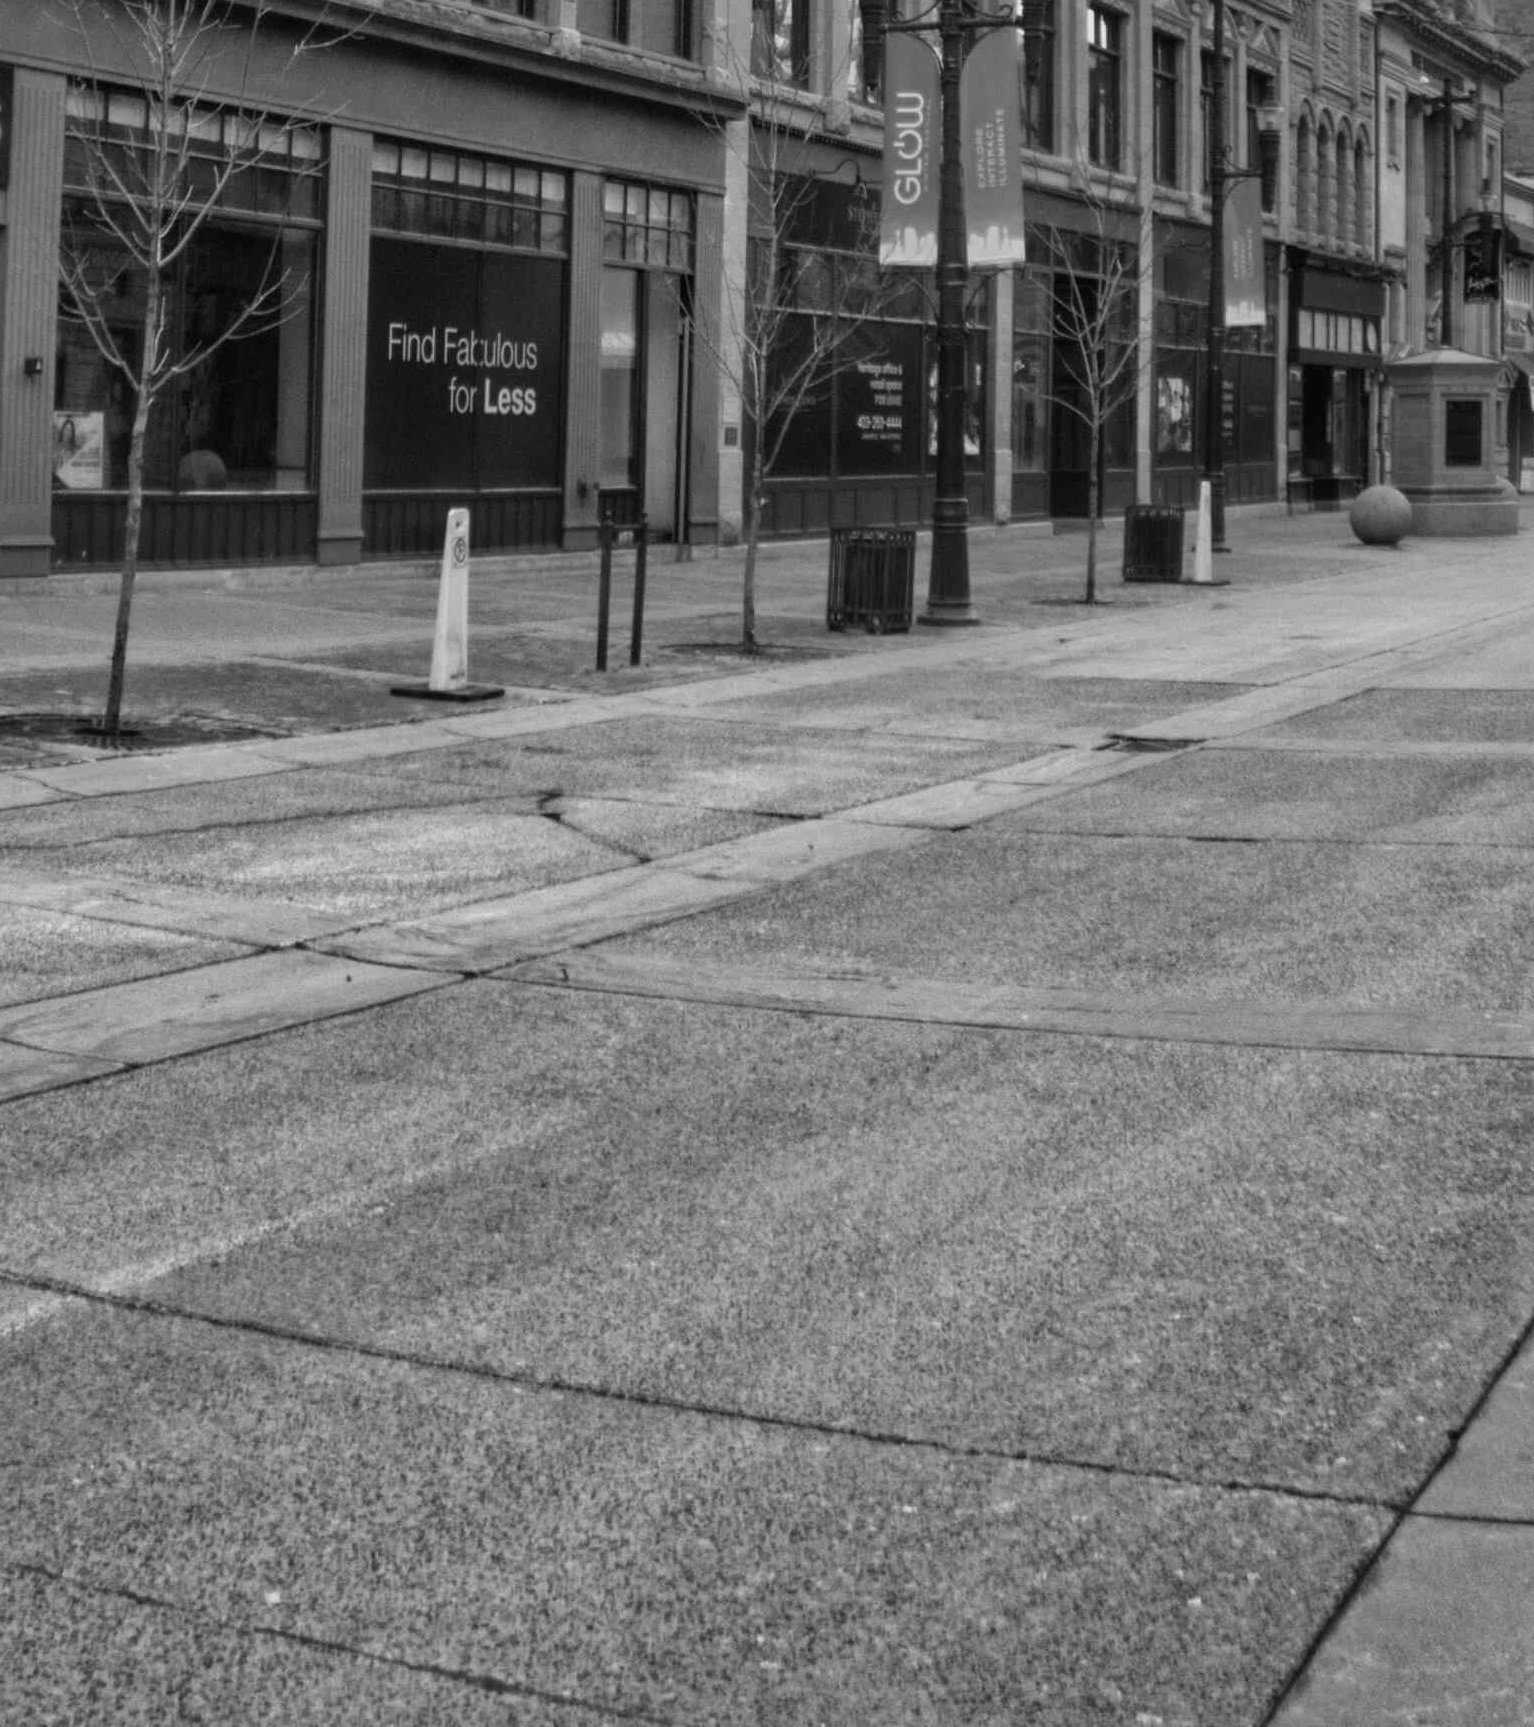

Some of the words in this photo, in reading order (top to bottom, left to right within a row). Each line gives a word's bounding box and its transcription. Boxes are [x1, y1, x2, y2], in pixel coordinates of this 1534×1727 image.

[892, 91, 924, 206] GLOW
[387, 321, 437, 364] Find
[442, 326, 539, 370] Fabulous
[448, 375, 479, 415] for
[482, 376, 538, 416] Less
